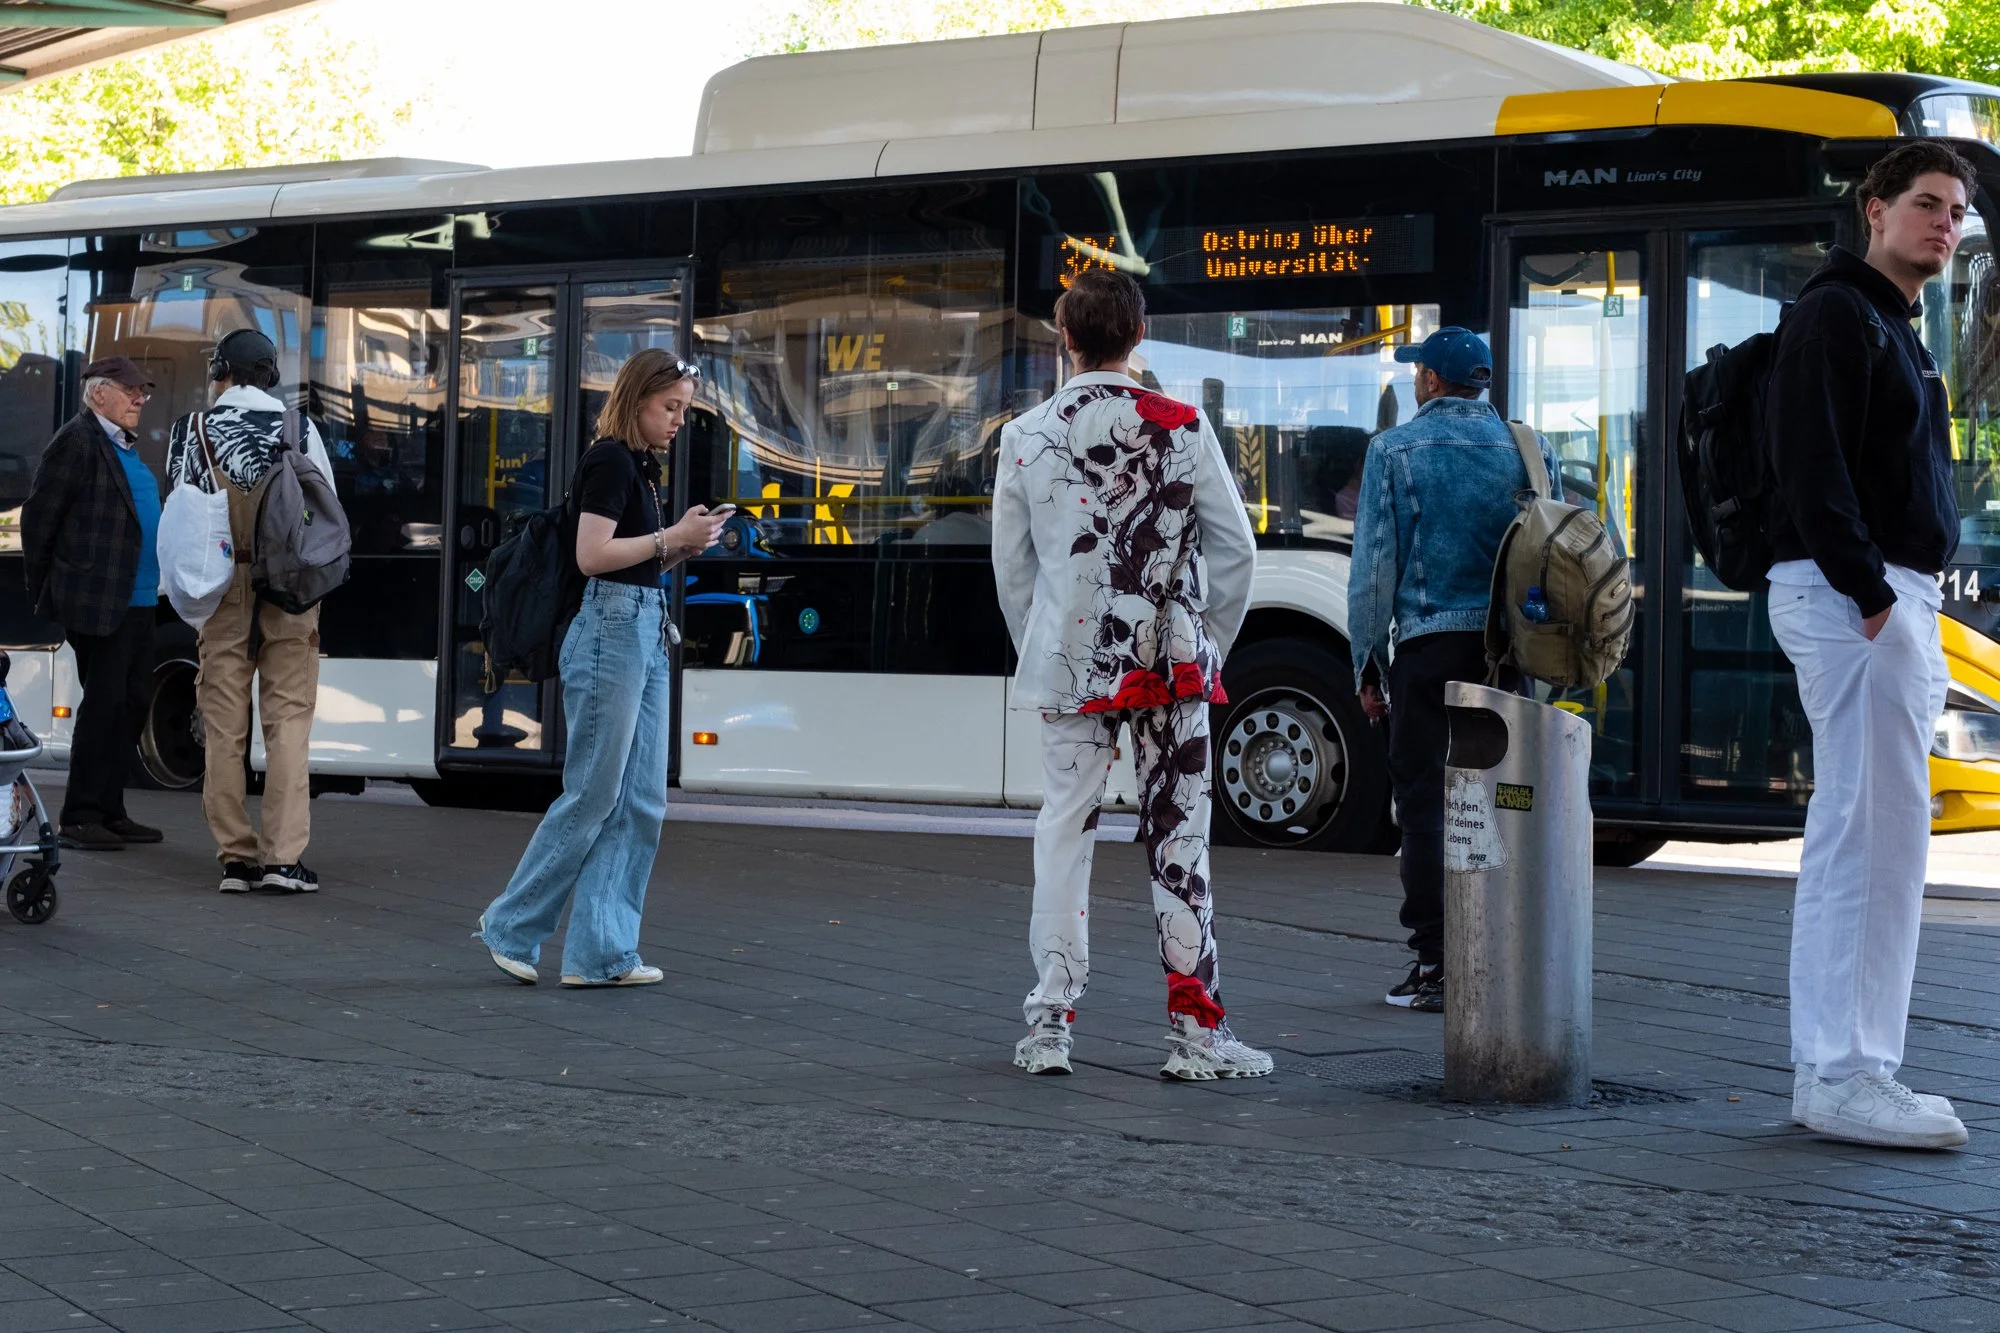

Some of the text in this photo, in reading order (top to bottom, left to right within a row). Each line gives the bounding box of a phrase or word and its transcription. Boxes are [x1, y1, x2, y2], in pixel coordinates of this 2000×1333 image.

[1543, 167, 1702, 187] MAN Lion's City
[1203, 228, 1300, 252] Ostring
[1300, 332, 1343, 345] MAN
[1461, 800, 1478, 812] den
[1454, 817, 1485, 829] deines
[1467, 853, 1487, 862] AWB
